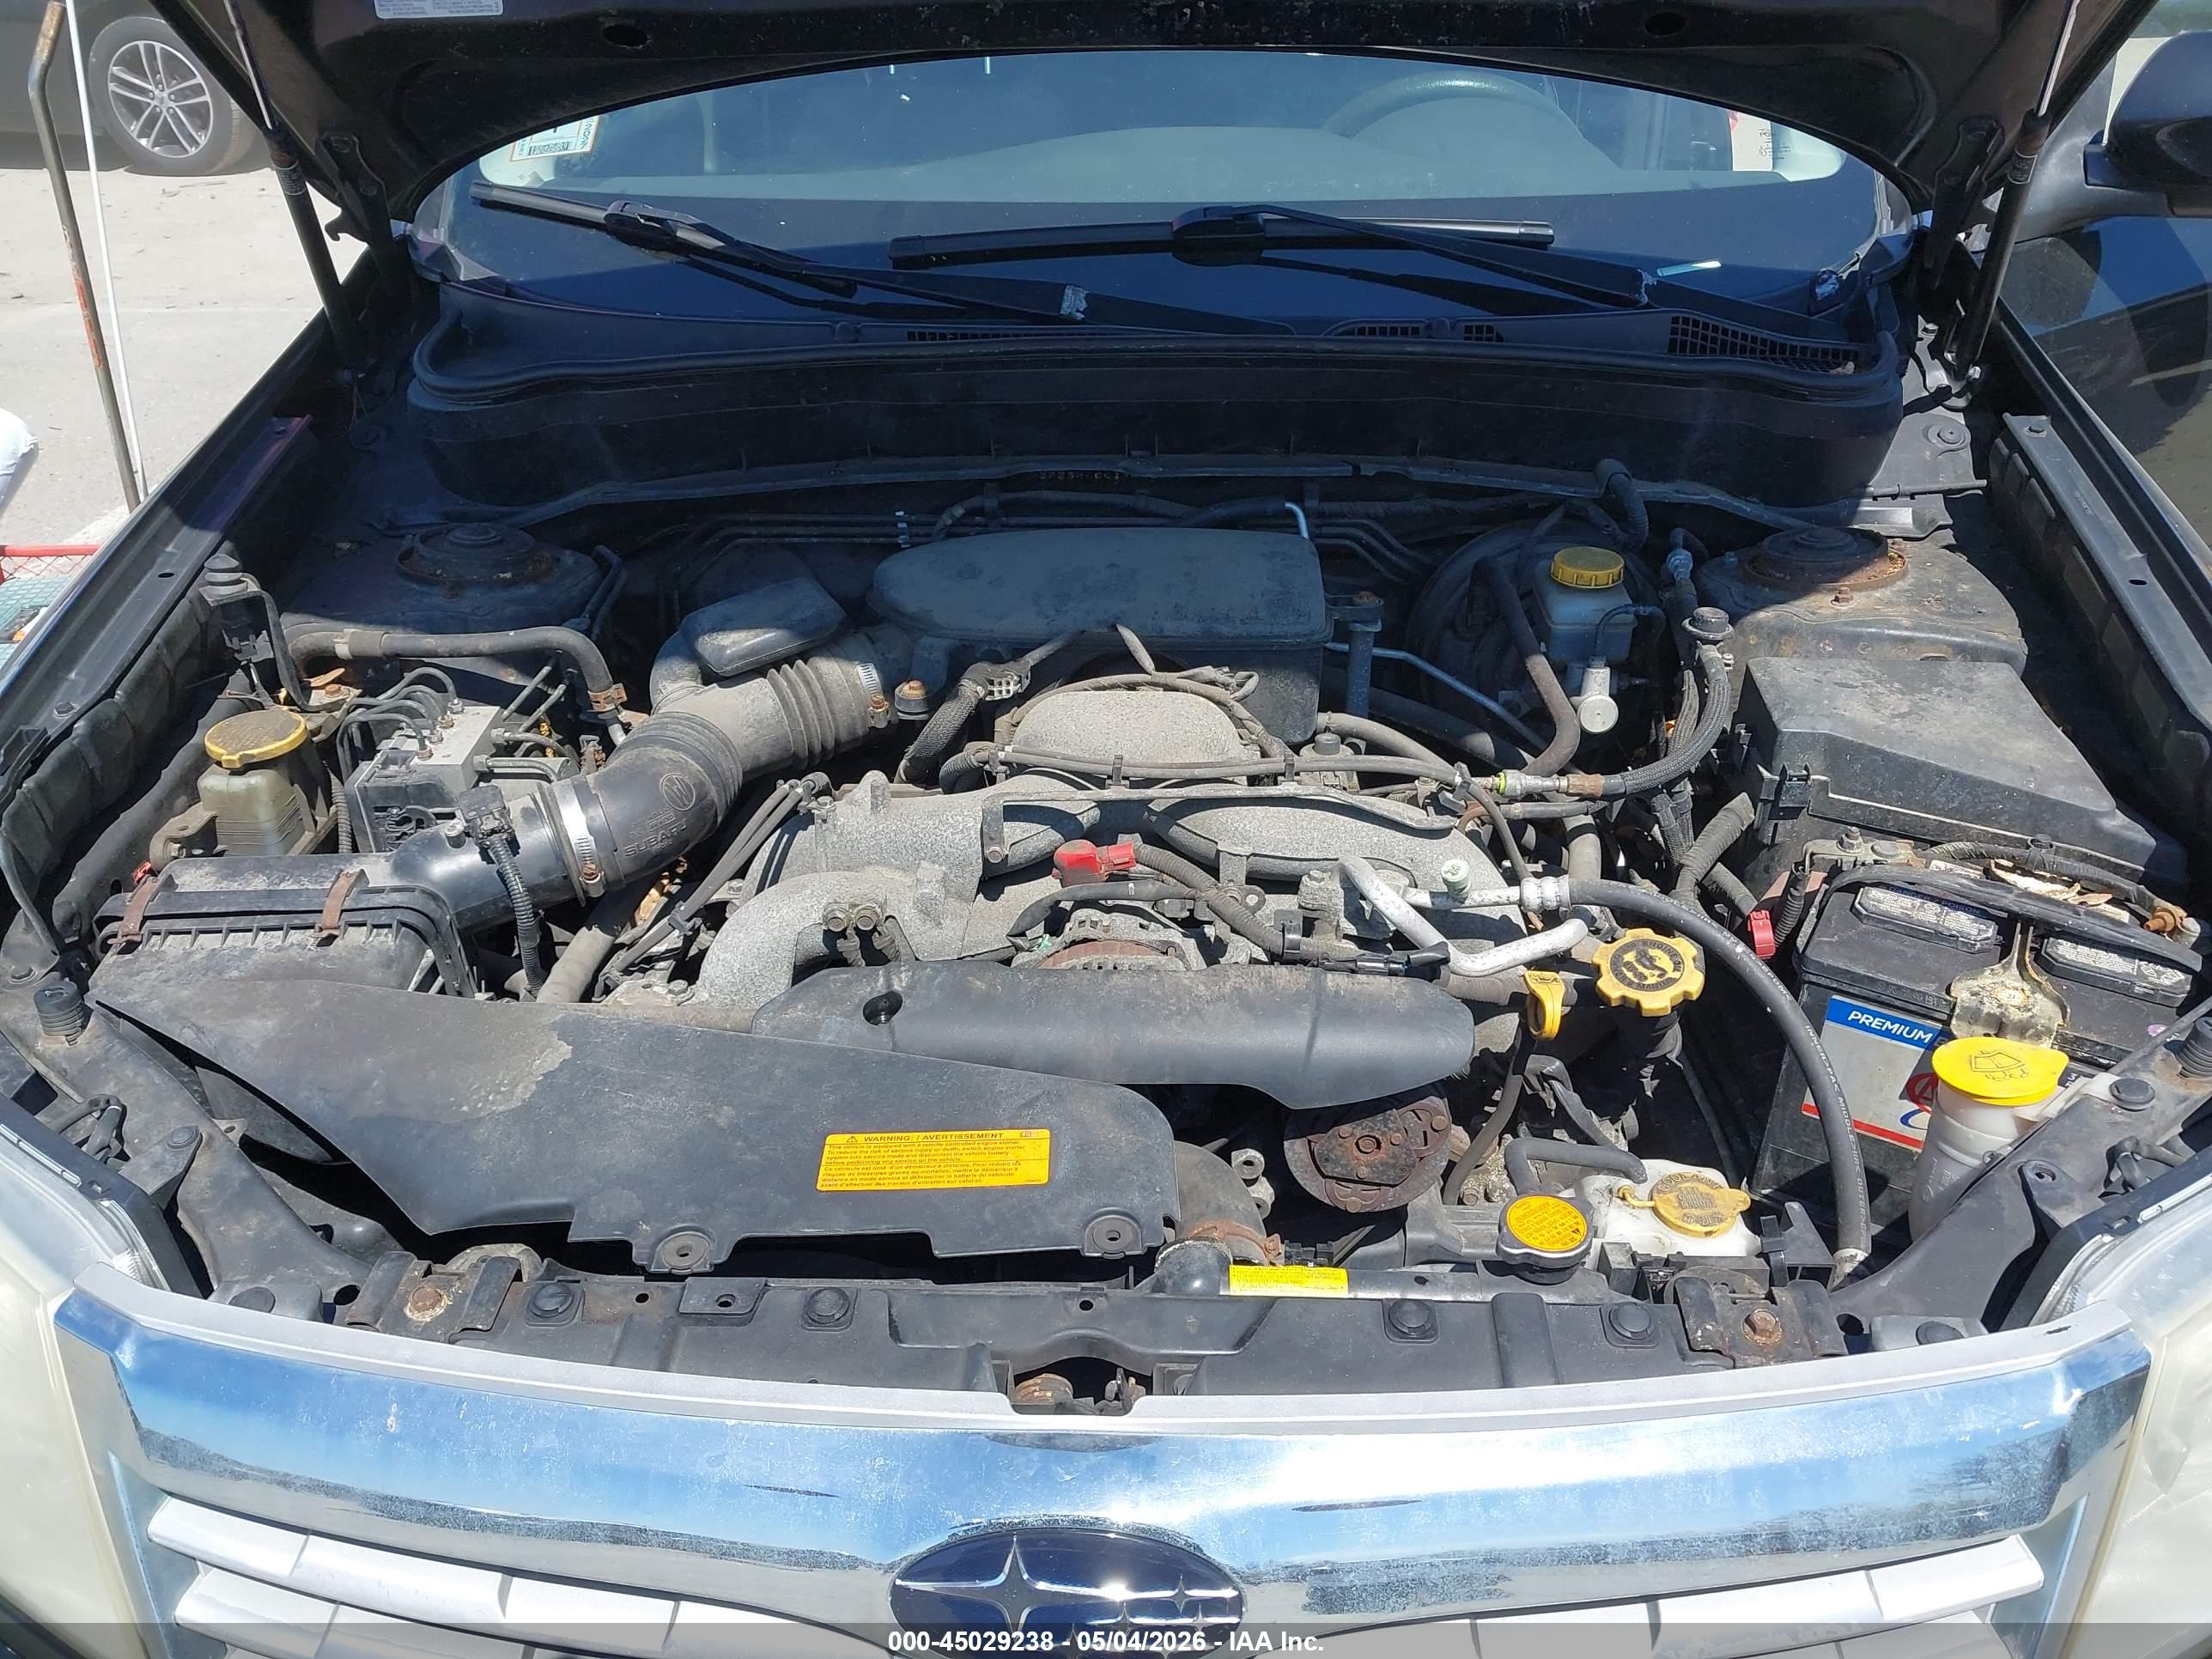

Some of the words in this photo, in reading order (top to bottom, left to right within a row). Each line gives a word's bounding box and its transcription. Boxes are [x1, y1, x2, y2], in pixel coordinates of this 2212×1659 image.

[580, 123, 592, 150] 2027
[1847, 1010, 1934, 1043] PREMIUM
[1657, 1173, 1723, 1193] COOLANT
